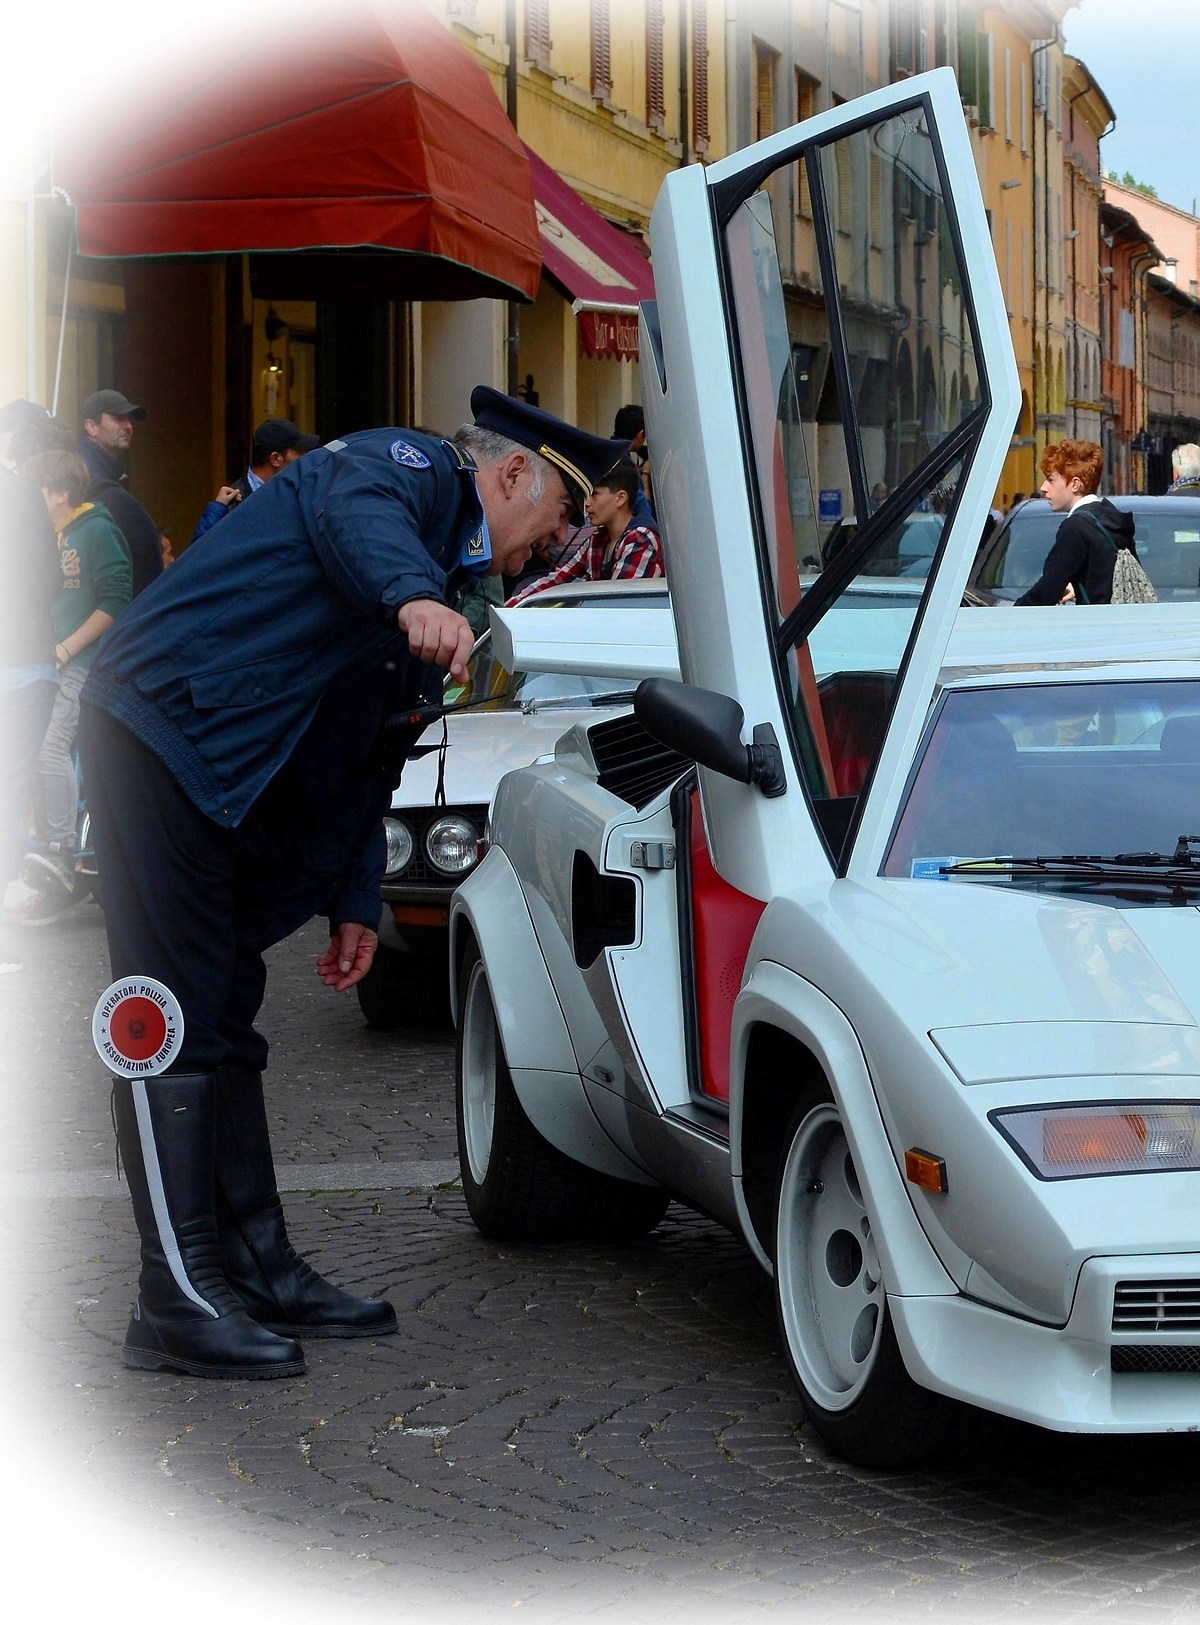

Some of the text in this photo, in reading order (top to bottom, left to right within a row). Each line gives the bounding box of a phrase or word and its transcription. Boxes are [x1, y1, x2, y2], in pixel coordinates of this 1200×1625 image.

[101, 985, 168, 1018] OPERATORI POLIZIA
[103, 1027, 176, 1072] ASSOCIAZIONE EUROPEA
